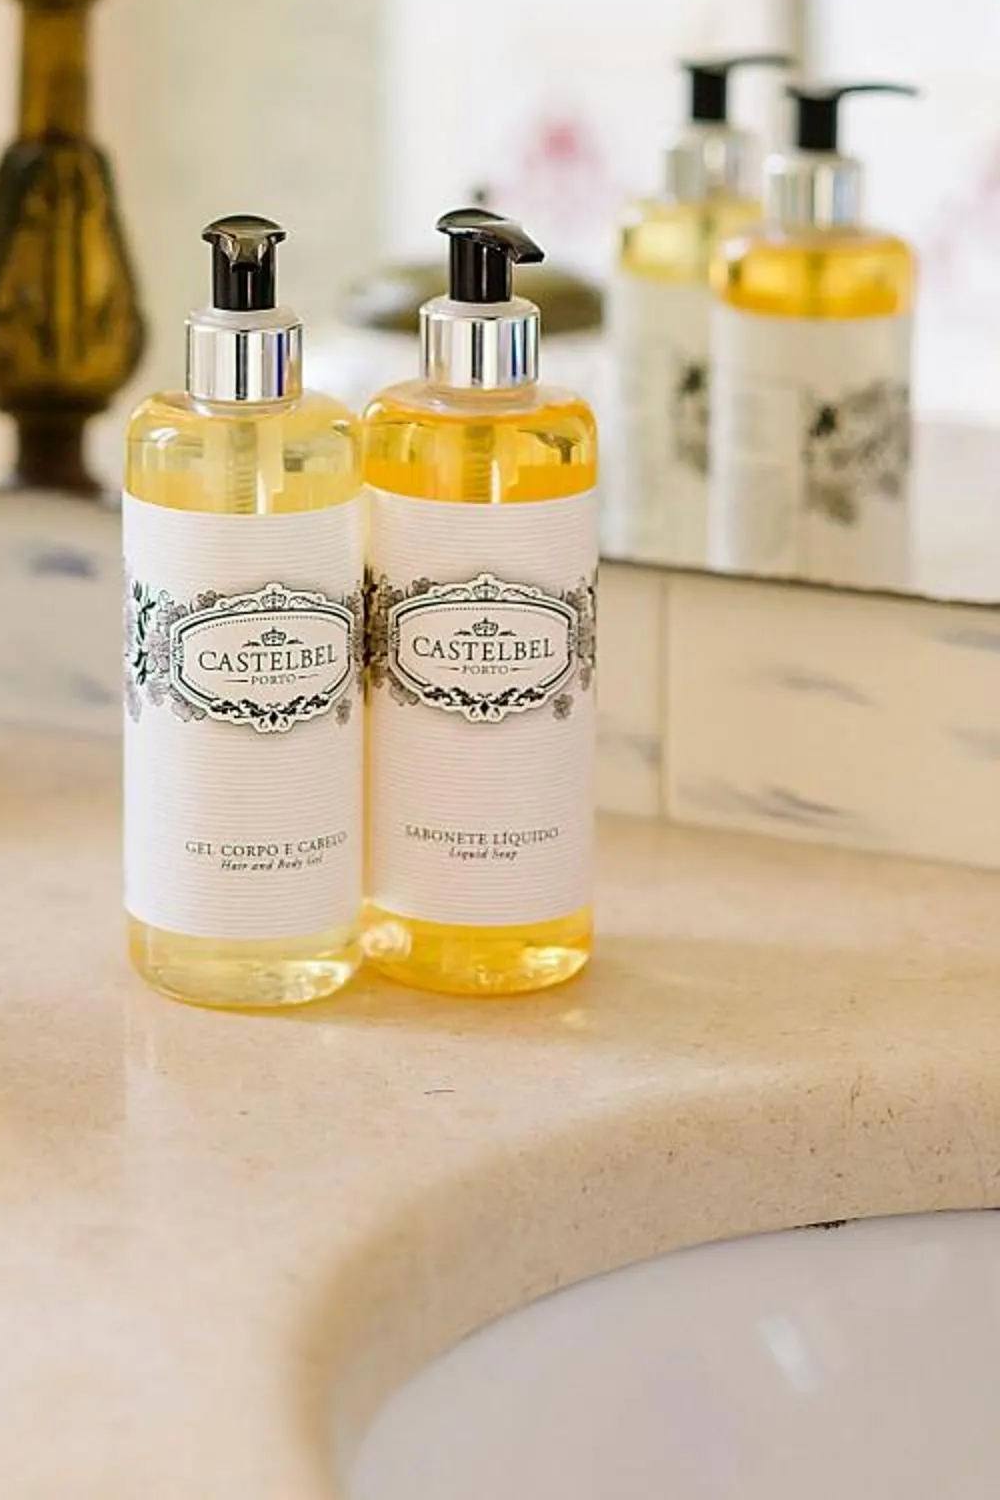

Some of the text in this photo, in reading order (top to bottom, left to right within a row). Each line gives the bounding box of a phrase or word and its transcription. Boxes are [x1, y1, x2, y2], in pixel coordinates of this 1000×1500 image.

[413, 636, 555, 662] CASTELBEL
[199, 644, 337, 673] CASTELBEL
[460, 665, 509, 675] PORTO
[251, 673, 297, 685] PORTO
[405, 824, 488, 845] SABONETE
[185, 841, 212, 855] GEL
[221, 843, 279, 857] CORPO
[284, 843, 293, 855] E
[448, 847, 489, 861] Liquid
[221, 859, 248, 871] Hair
[251, 860, 275, 871] and
